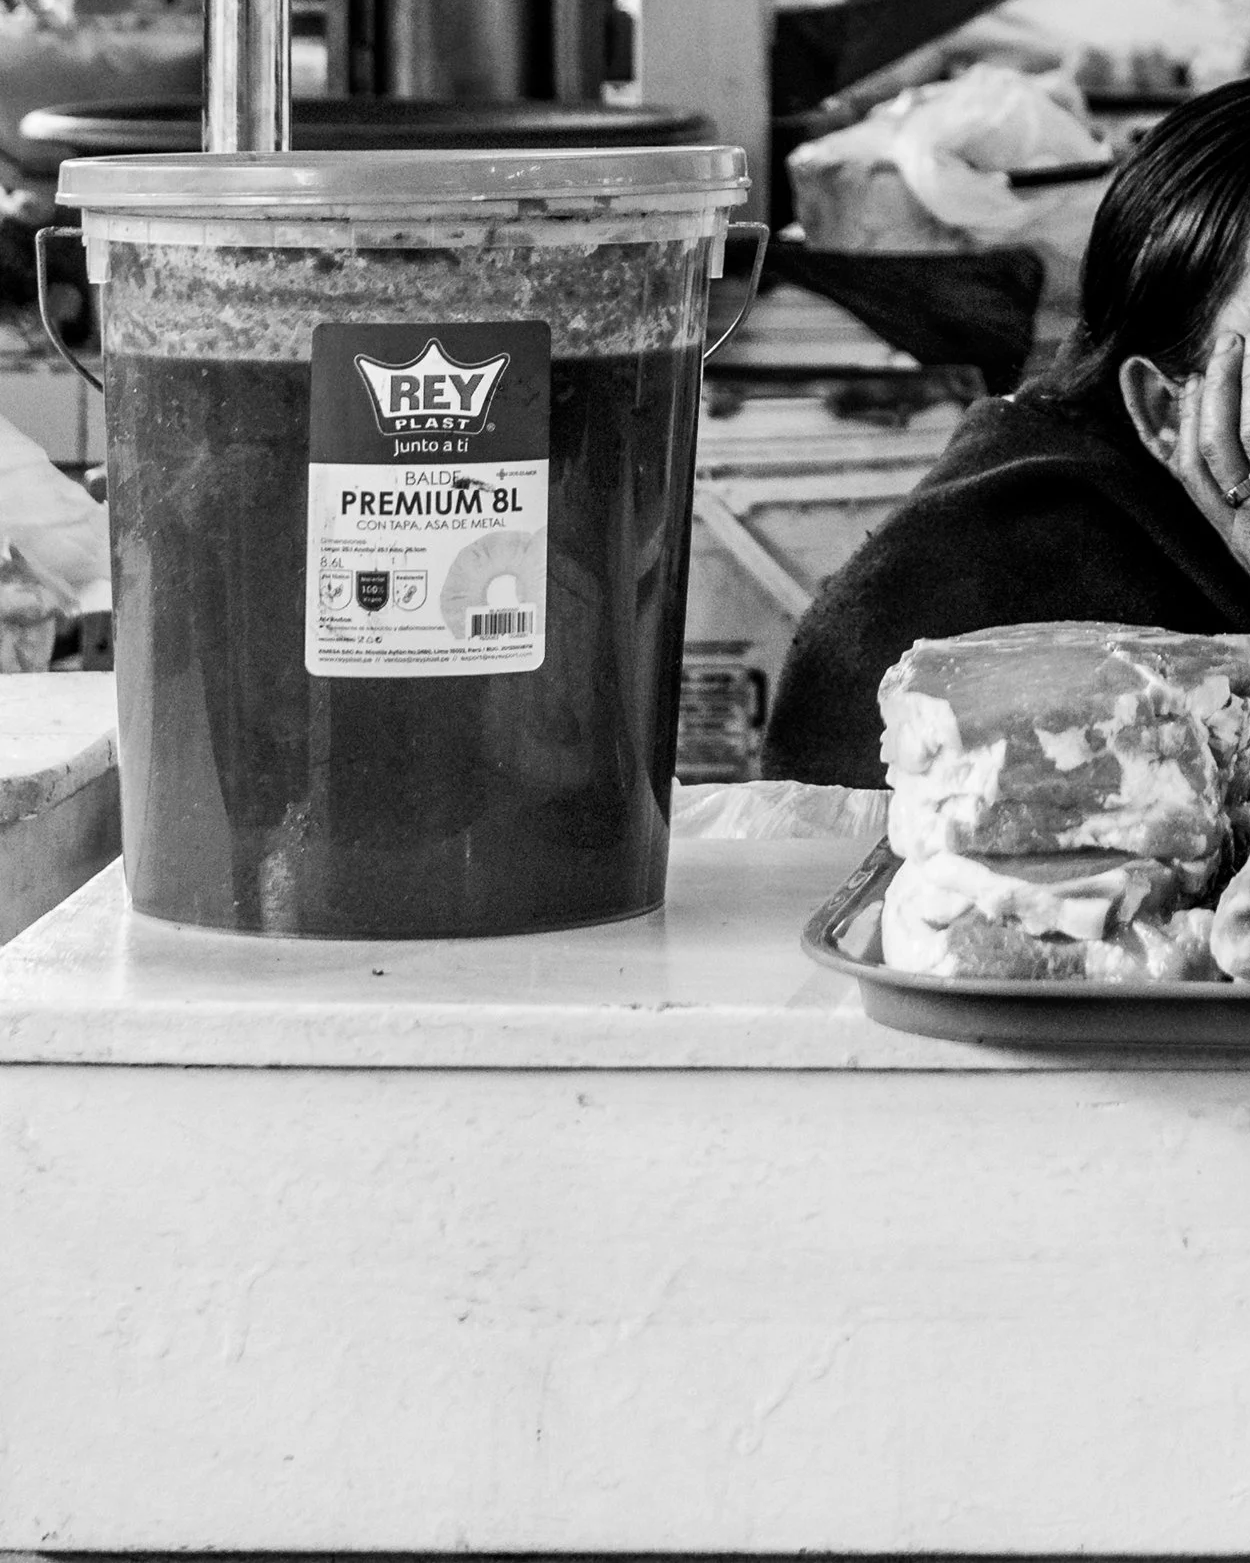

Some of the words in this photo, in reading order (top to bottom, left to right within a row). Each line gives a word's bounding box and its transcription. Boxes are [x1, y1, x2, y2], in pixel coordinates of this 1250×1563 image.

[389, 373, 486, 413] REY
[394, 417, 471, 431] PLAST
[393, 438, 439, 457] Junto
[443, 441, 453, 453] a
[405, 470, 462, 486] BALDE
[341, 489, 483, 516] PREMIUM
[492, 487, 523, 513] 8L
[356, 519, 387, 531] CON
[424, 518, 450, 531] ASA
[452, 518, 468, 530] DE
[471, 516, 507, 529] METAL
[320, 556, 344, 569] 8.6L
[362, 584, 385, 595] 100%
